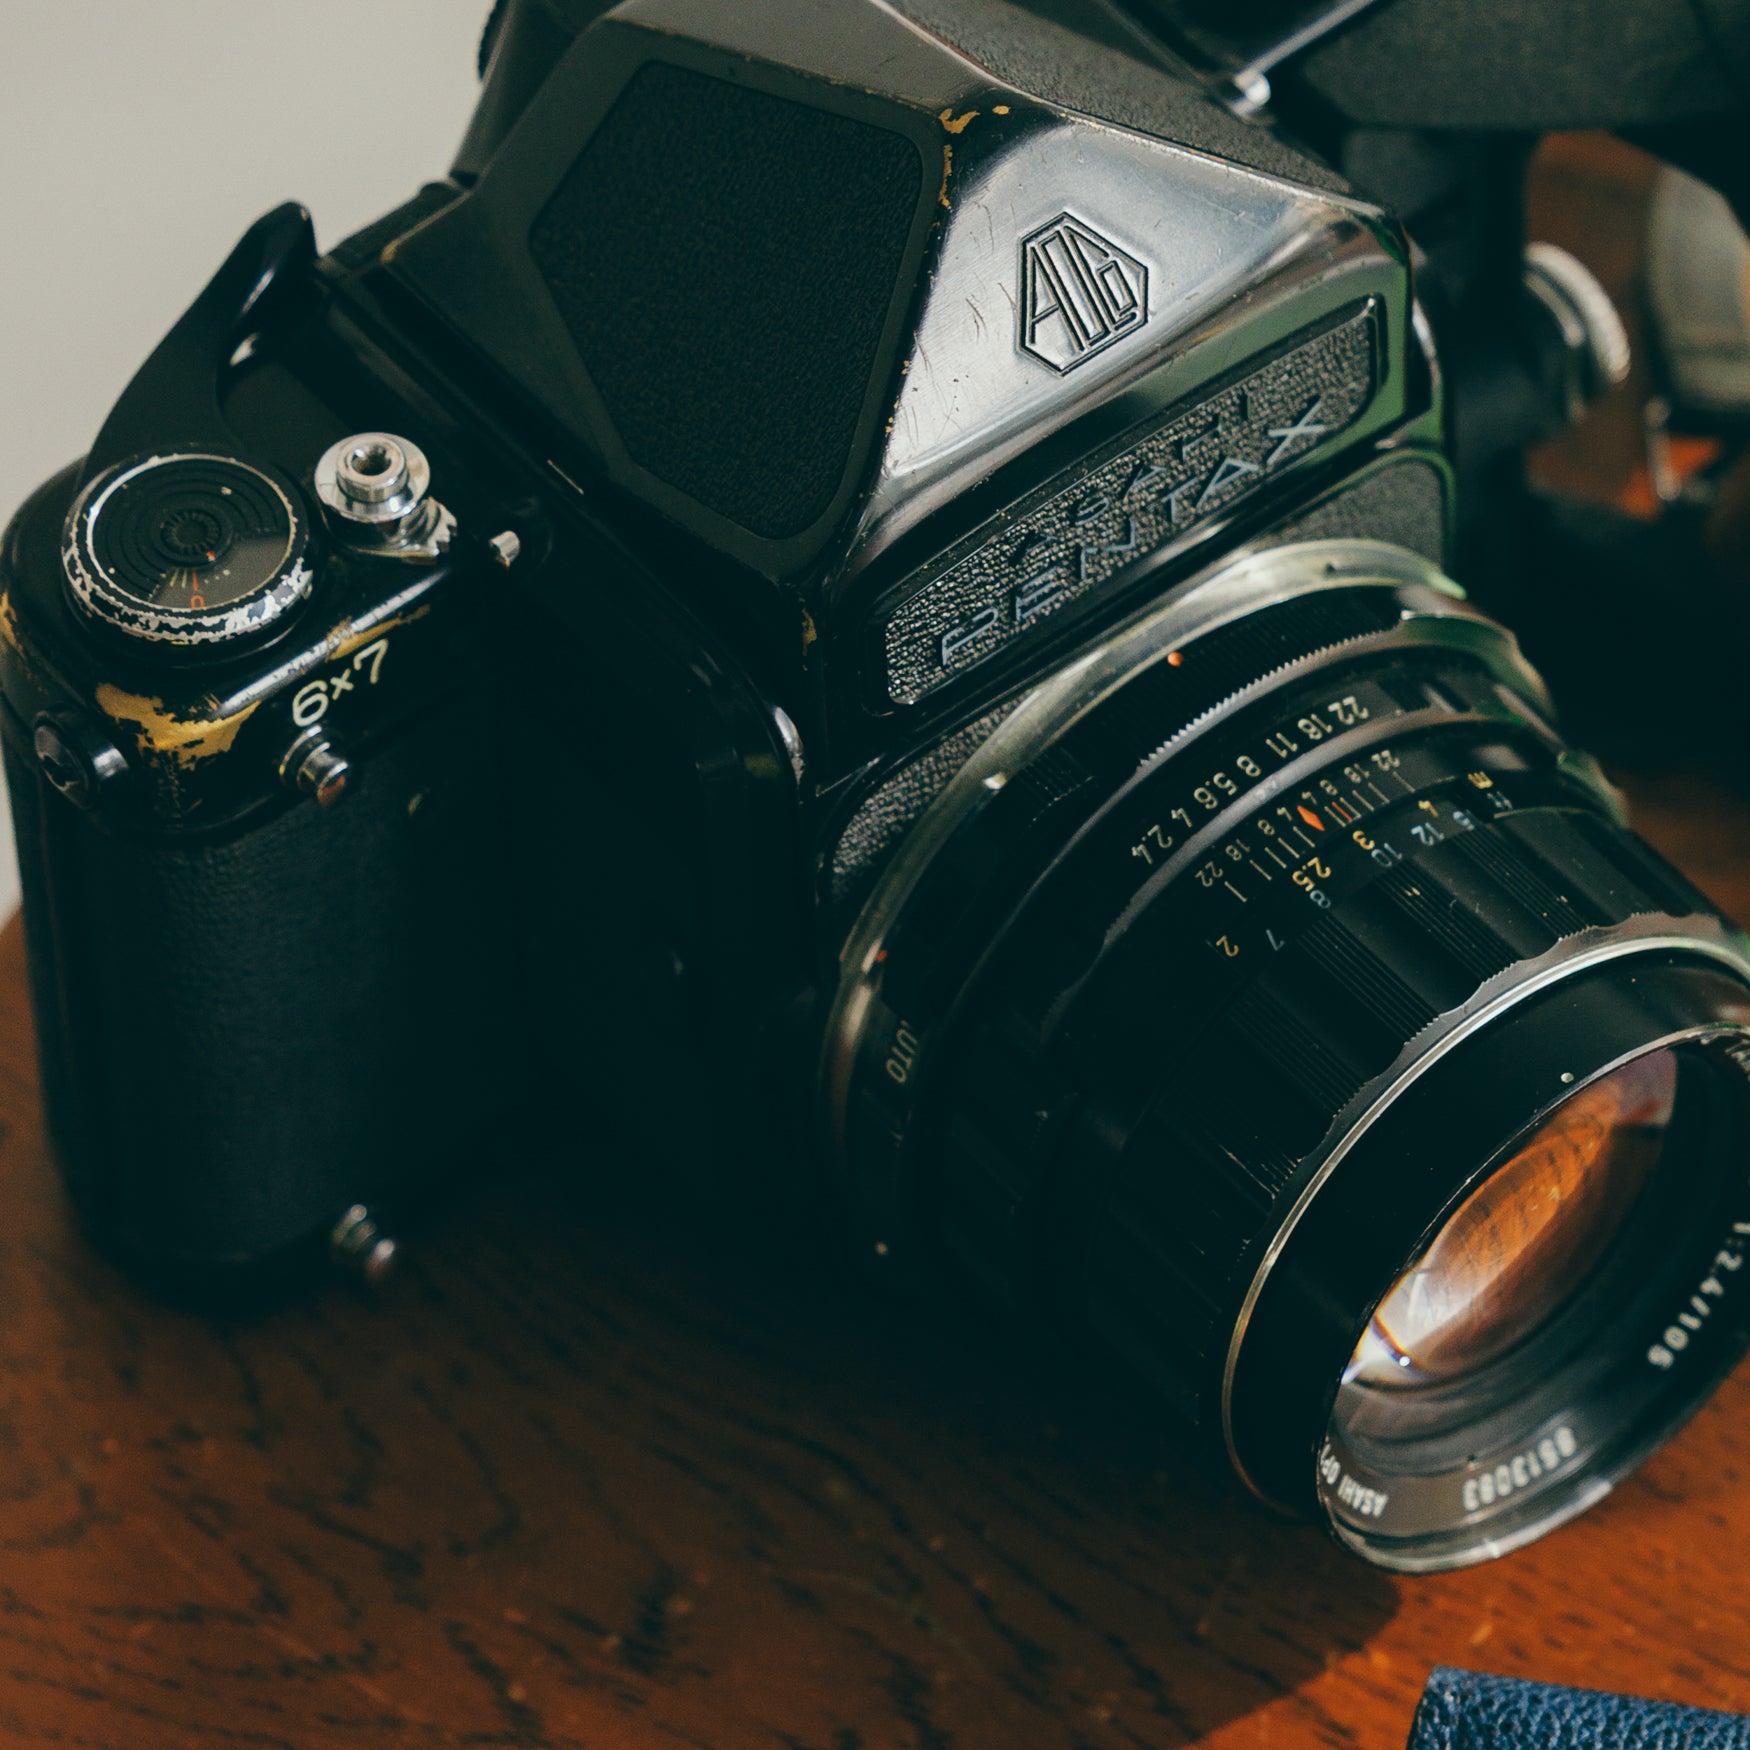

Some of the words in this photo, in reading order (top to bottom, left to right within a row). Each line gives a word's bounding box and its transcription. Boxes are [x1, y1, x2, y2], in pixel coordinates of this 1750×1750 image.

[941, 400, 1328, 667] PENTAX
[1327, 696, 1369, 724] 22
[1297, 713, 1333, 740] 16
[1265, 732, 1298, 758] 11
[1236, 755, 1261, 777] 8
[1371, 749, 1400, 771] 22
[1344, 763, 1370, 783] 16
[1193, 772, 1238, 810] 5.6
[1319, 779, 1338, 796] 8
[1171, 807, 1192, 828] 4
[1276, 806, 1293, 822] 4
[1257, 819, 1276, 836] 8
[1411, 822, 1445, 846] 12
[1131, 824, 1173, 865] 2.4
[1352, 830, 1375, 850] 3
[1371, 842, 1402, 867] 10
[1195, 861, 1223, 888] 22
[1292, 856, 1332, 892] 2.5
[1310, 889, 1332, 909] 8
[1216, 935, 1239, 957] 2
